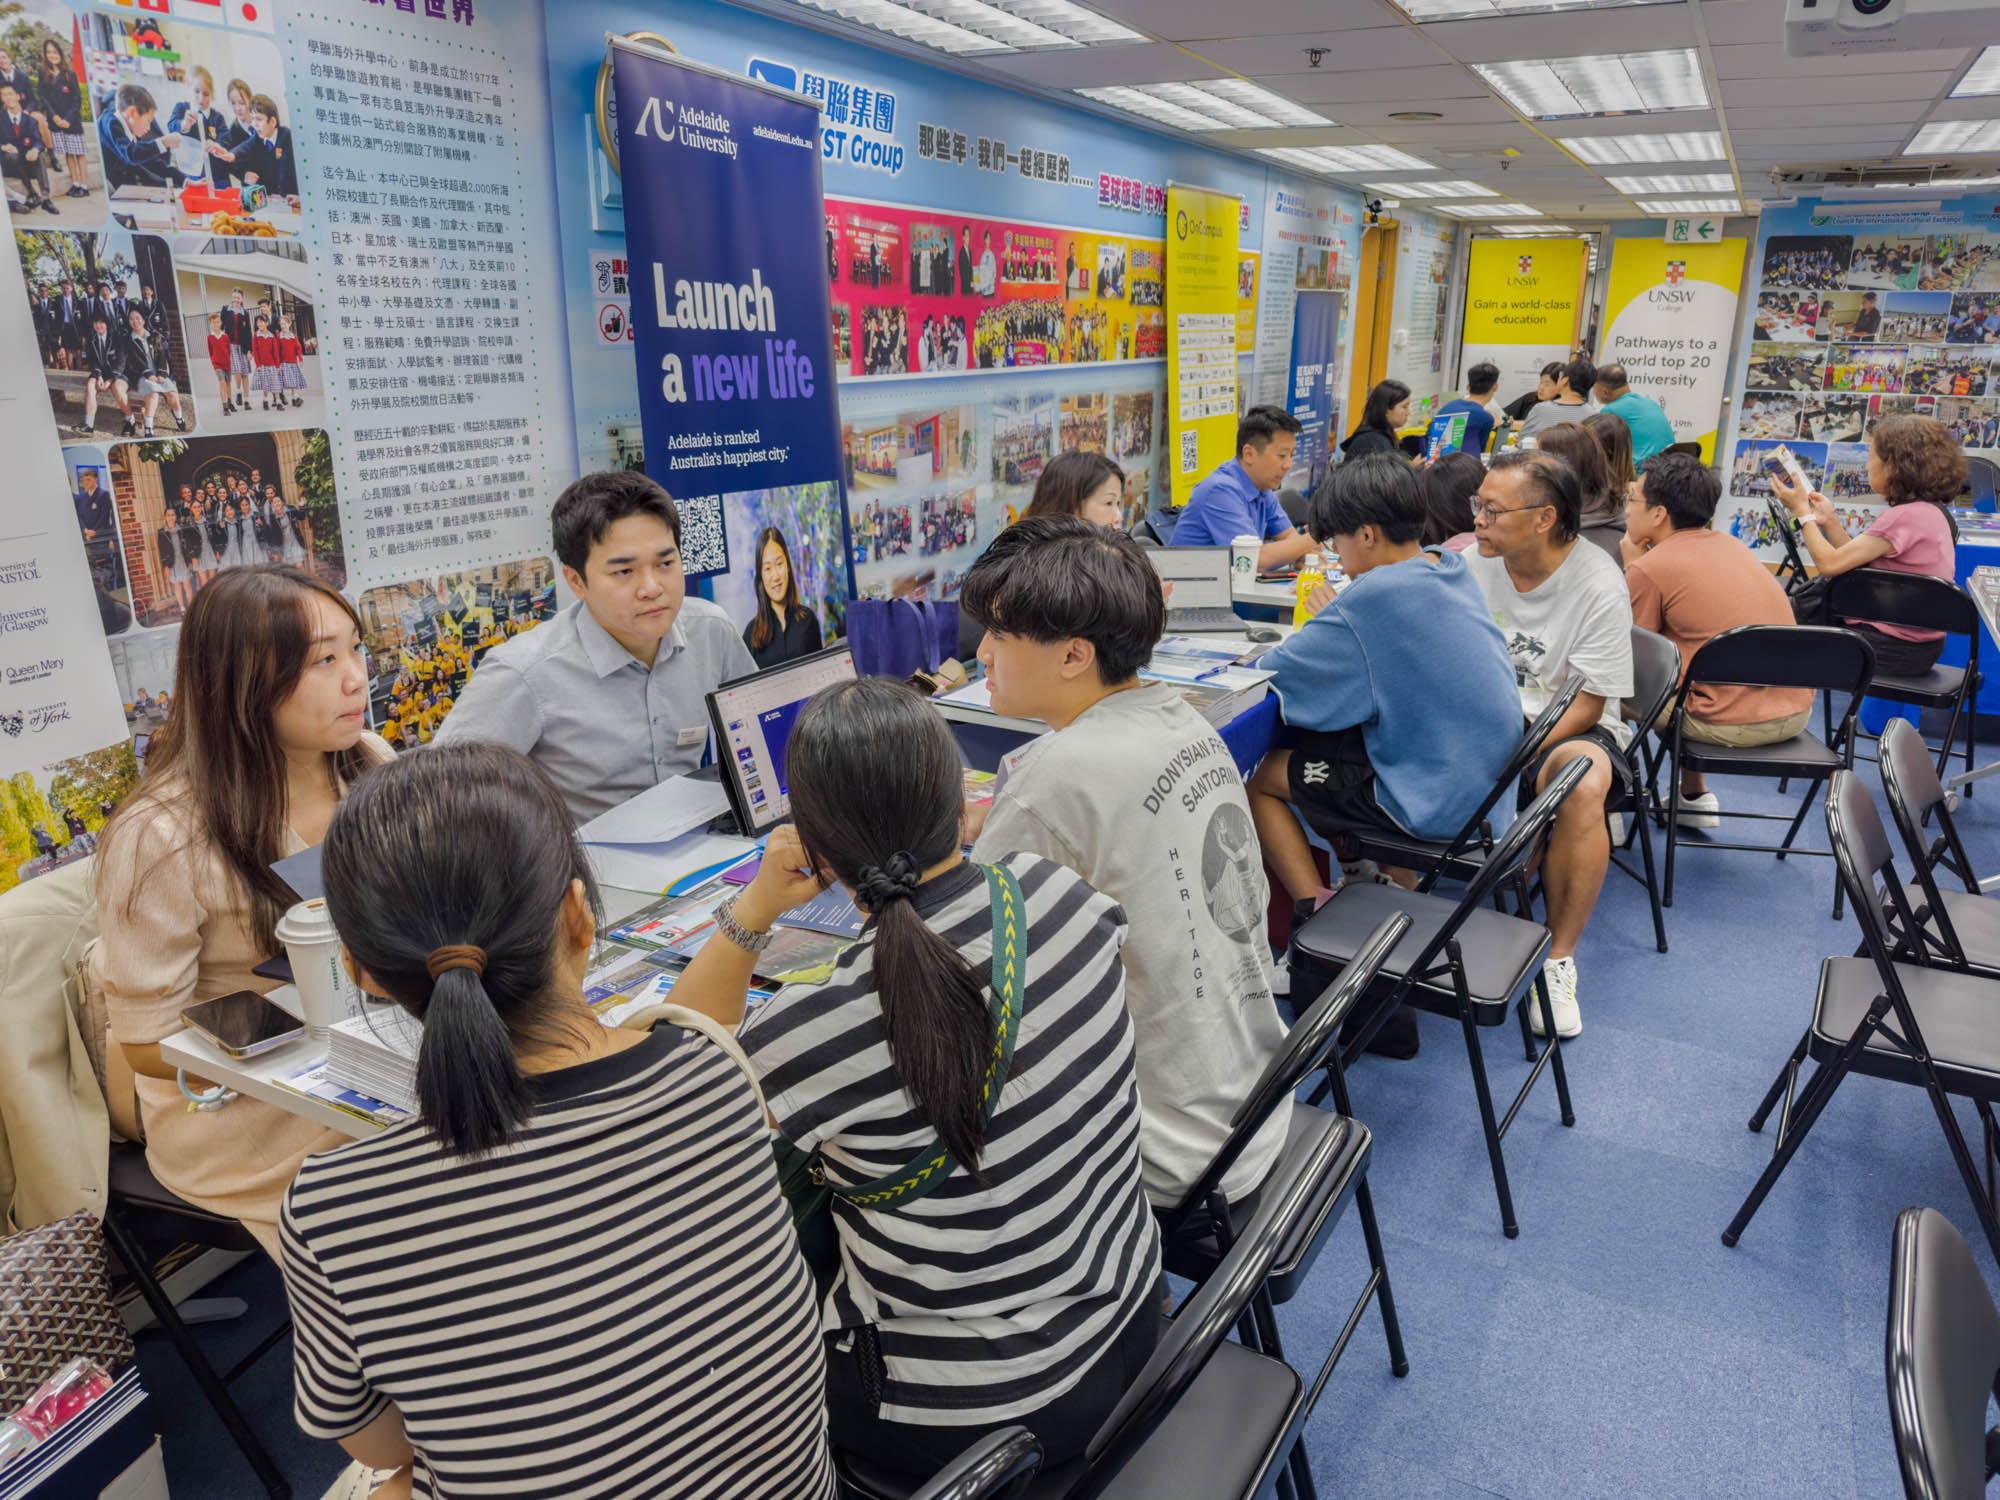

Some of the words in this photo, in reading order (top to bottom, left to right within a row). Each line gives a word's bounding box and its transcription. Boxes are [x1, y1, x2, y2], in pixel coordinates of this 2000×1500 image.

[678, 104, 731, 134] Adelaide
[679, 126, 738, 160] University
[753, 125, 813, 150] adelaideuni.edu.au
[851, 134, 903, 174] Group
[1144, 184, 1167, 216] 中外
[1932, 215, 1961, 225] Exchange
[1507, 276, 1540, 287] UNSW
[653, 262, 777, 332] Launch
[1474, 299, 1498, 310] Gain
[1501, 302, 1507, 310] a
[1510, 299, 1571, 310] world-class
[1648, 290, 1695, 303] UNSW
[1494, 314, 1547, 325] education
[1615, 336, 1684, 351] Pathways
[1688, 338, 1703, 350] to
[1708, 340, 1717, 350] a
[661, 353, 687, 403] a
[692, 353, 759, 401] new
[765, 338, 815, 399] life
[1616, 355, 1656, 367] world
[1661, 356, 1685, 371] top
[1690, 356, 1711, 368] 20
[668, 433, 712, 450] Adelaide
[713, 433, 722, 446] is
[724, 430, 760, 445] ranked
[670, 451, 722, 470] Australia's
[723, 447, 767, 467] happiest
[28, 558, 36, 568] of
[5, 617, 49, 633] Glasgow
[6, 663, 39, 679] Queen
[40, 658, 64, 671] Mary
[28, 701, 67, 714] UNIVERSITY
[30, 714, 40, 727] of
[32, 708, 71, 733] York
[1143, 739, 1210, 815] DIONYSIAN
[1169, 848, 1204, 998] HERITAGE
